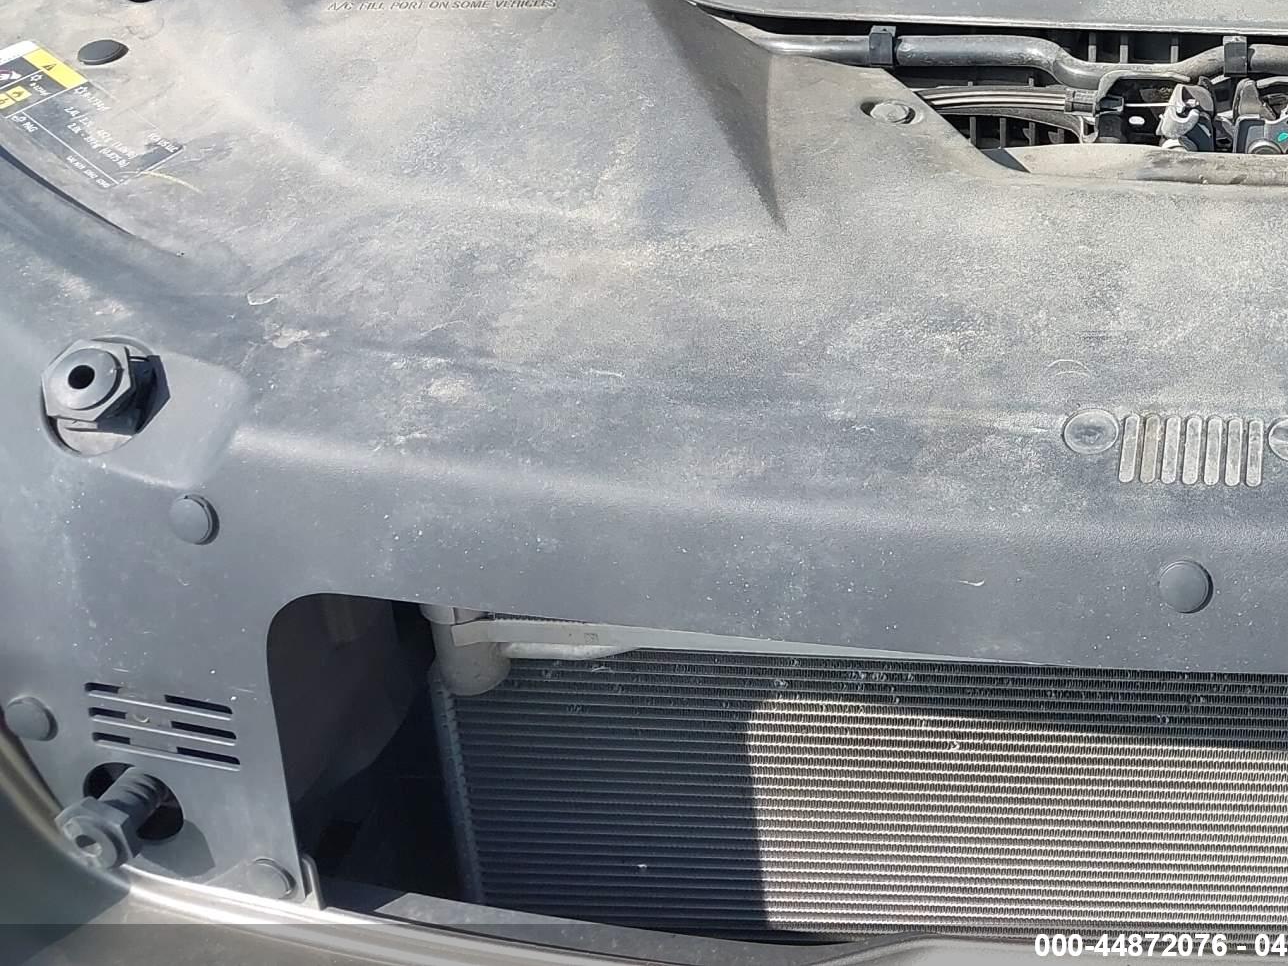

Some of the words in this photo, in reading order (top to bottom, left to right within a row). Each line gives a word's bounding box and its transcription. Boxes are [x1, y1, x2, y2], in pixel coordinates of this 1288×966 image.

[358, 1, 385, 11] FILL
[390, 1, 424, 10] PORT
[428, 1, 450, 10] ON
[451, 0, 490, 9] SOME
[494, 0, 558, 8] VEHICLES
